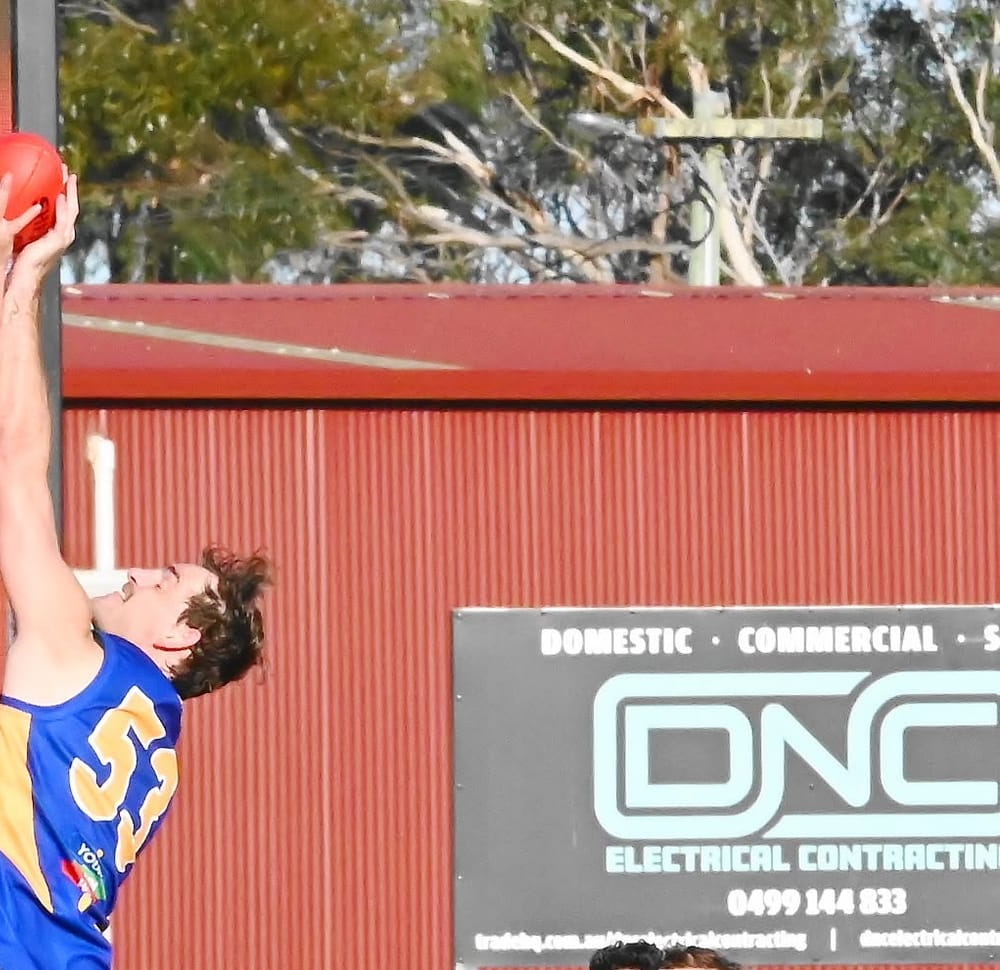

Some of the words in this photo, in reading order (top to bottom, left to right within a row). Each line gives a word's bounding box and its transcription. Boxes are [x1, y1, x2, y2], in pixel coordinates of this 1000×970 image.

[540, 627, 693, 655] DOMESTIC
[738, 625, 938, 653] COMMERCIAL
[593, 671, 1000, 839] DNC
[606, 846, 791, 873] ELECTRICAL
[799, 843, 1000, 872] CONTRACTIN
[727, 890, 801, 917] 0499
[805, 889, 855, 916] 144
[859, 888, 908, 915] 833
